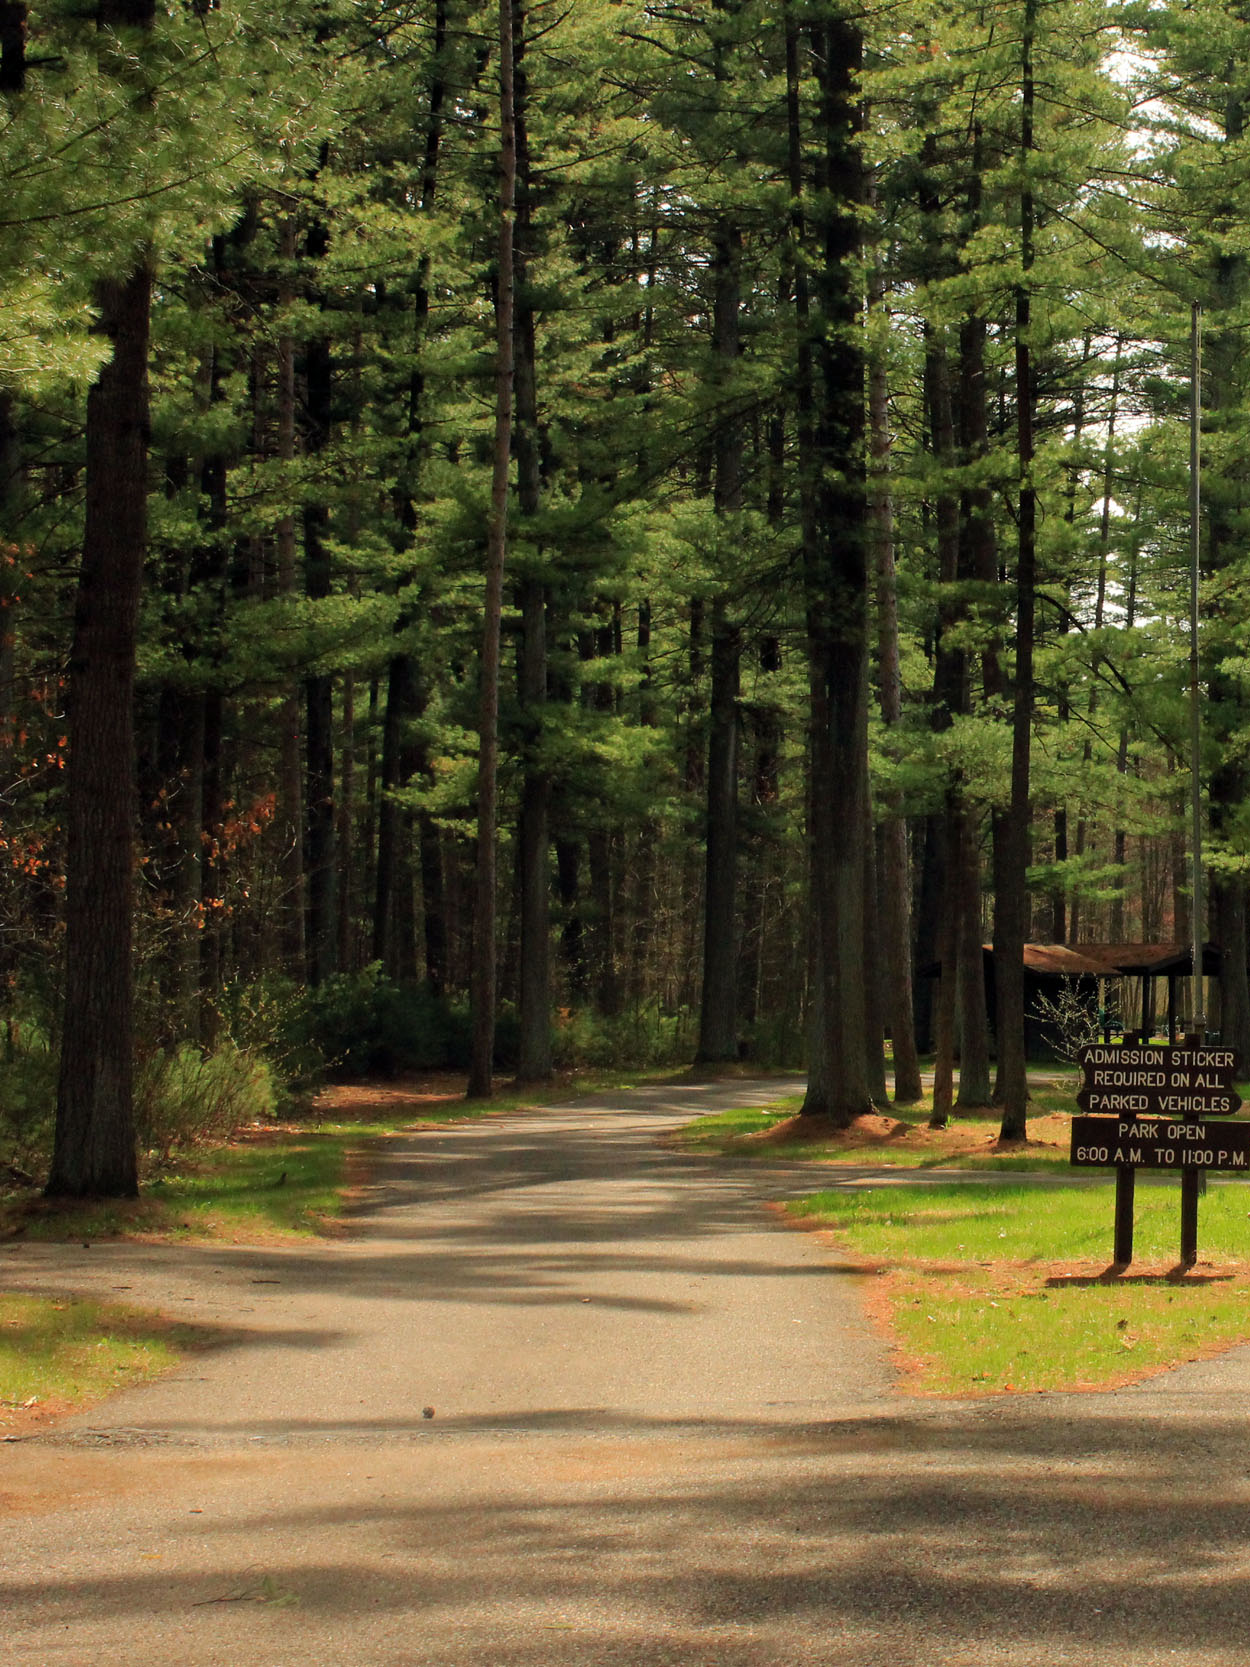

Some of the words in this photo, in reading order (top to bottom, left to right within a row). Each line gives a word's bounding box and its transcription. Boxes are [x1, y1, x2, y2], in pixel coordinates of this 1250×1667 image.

[1084, 1049, 1164, 1066] ADMISSION
[1171, 1051, 1235, 1067] STICKER
[1094, 1070, 1166, 1087] REQUIRED
[1171, 1072, 1190, 1088] ON
[1194, 1073, 1225, 1088] ALL
[1089, 1094, 1149, 1110] PARKED
[1158, 1096, 1230, 1112] VEHICLES
[1118, 1123, 1159, 1139] PARK
[1167, 1124, 1206, 1140] OPEN
[1076, 1146, 1108, 1161] 6:00
[1113, 1148, 1146, 1163] A.M.
[1154, 1148, 1175, 1164] TO
[1182, 1149, 1213, 1165] 11:00
[1217, 1150, 1248, 1166] P.M.
